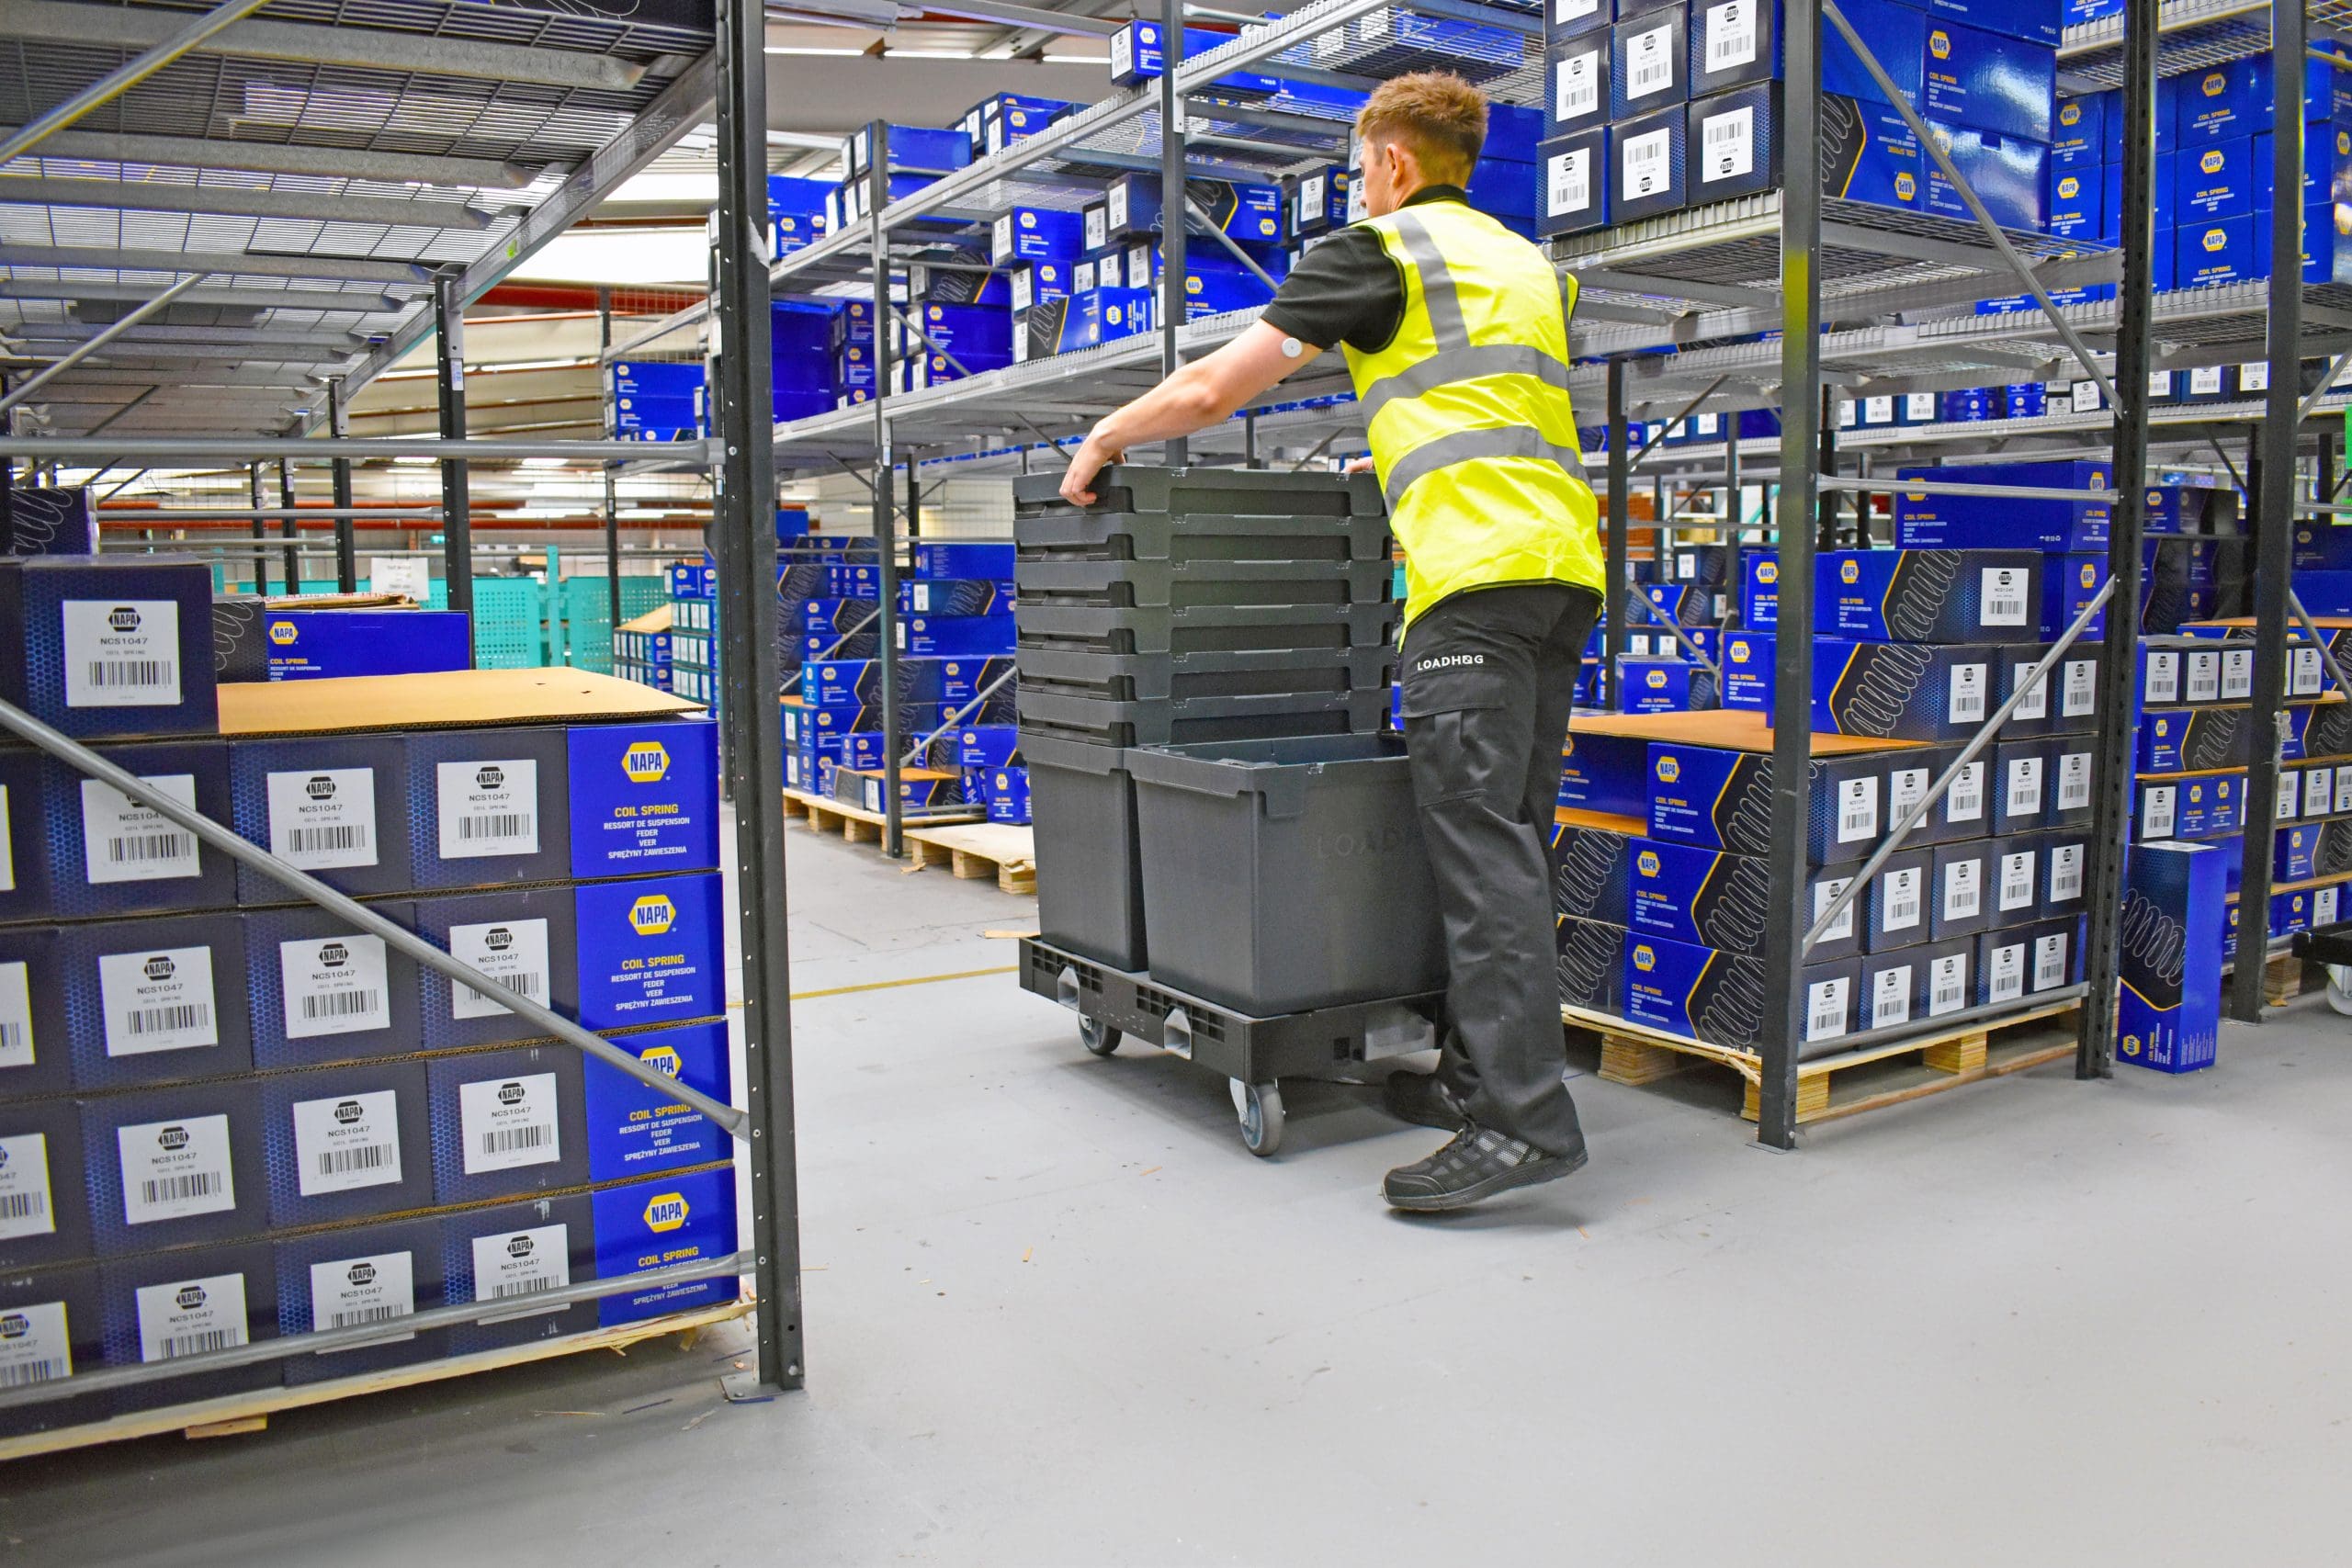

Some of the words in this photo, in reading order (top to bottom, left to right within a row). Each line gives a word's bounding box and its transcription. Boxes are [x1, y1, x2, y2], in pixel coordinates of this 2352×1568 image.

[2206, 79, 2222, 90] NAPA
[2205, 156, 2221, 167] NAPA
[2062, 184, 2075, 193] NAPA
[2207, 234, 2223, 246] NAPA
[1760, 568, 1775, 577] NAPA
[114, 614, 137, 626] NAPA
[274, 628, 293, 638] NAPA
[1418, 655, 1484, 671] LOADHOG
[630, 752, 662, 772] NAPA
[1660, 762, 1676, 776] NAPA
[481, 773, 501, 784] NAPA
[311, 783, 332, 794] NAPA
[299, 805, 343, 813] NCS1047
[615, 807, 639, 818] COIL
[641, 804, 679, 816] SPRING
[604, 820, 635, 830] RESSORT
[647, 818, 690, 827] SUSPENSION
[637, 829, 659, 838] FEDER
[637, 905, 669, 925] NAPA
[490, 933, 509, 944] NAPA
[323, 949, 345, 962] NAPA
[478, 953, 519, 964] NCS1047
[622, 959, 645, 970] COIL
[648, 954, 684, 967] SPRING
[149, 963, 171, 975] NAPA
[611, 973, 642, 983] RESSORT
[653, 966, 696, 978] SUSPENSION
[312, 970, 356, 981] NCS1047
[137, 983, 184, 995] NCS1047
[643, 979, 665, 988] FEDER
[646, 989, 663, 998] VEER
[503, 1088, 521, 1100] NAPA
[339, 1107, 359, 1119] NAPA
[492, 1107, 531, 1118] NCS1047
[629, 1111, 652, 1122] COIL
[619, 1123, 650, 1134] RESSORT
[662, 1114, 703, 1126] SUSPENSION
[328, 1125, 370, 1138] NCS1047
[650, 1128, 673, 1138] FEDER
[163, 1133, 185, 1145] NAPA
[653, 1138, 671, 1146] VEER
[152, 1152, 198, 1165] NCS1047
[651, 1202, 682, 1224] NAPA
[511, 1241, 530, 1252] NAPA
[639, 1256, 661, 1267] COIL
[663, 1247, 699, 1261] SPRING
[501, 1258, 540, 1270] NCS1047
[352, 1269, 373, 1280] NAPA
[181, 1292, 202, 1303] NAPA
[341, 1287, 383, 1299] NCS1047
[169, 1310, 214, 1323] NCS1047
